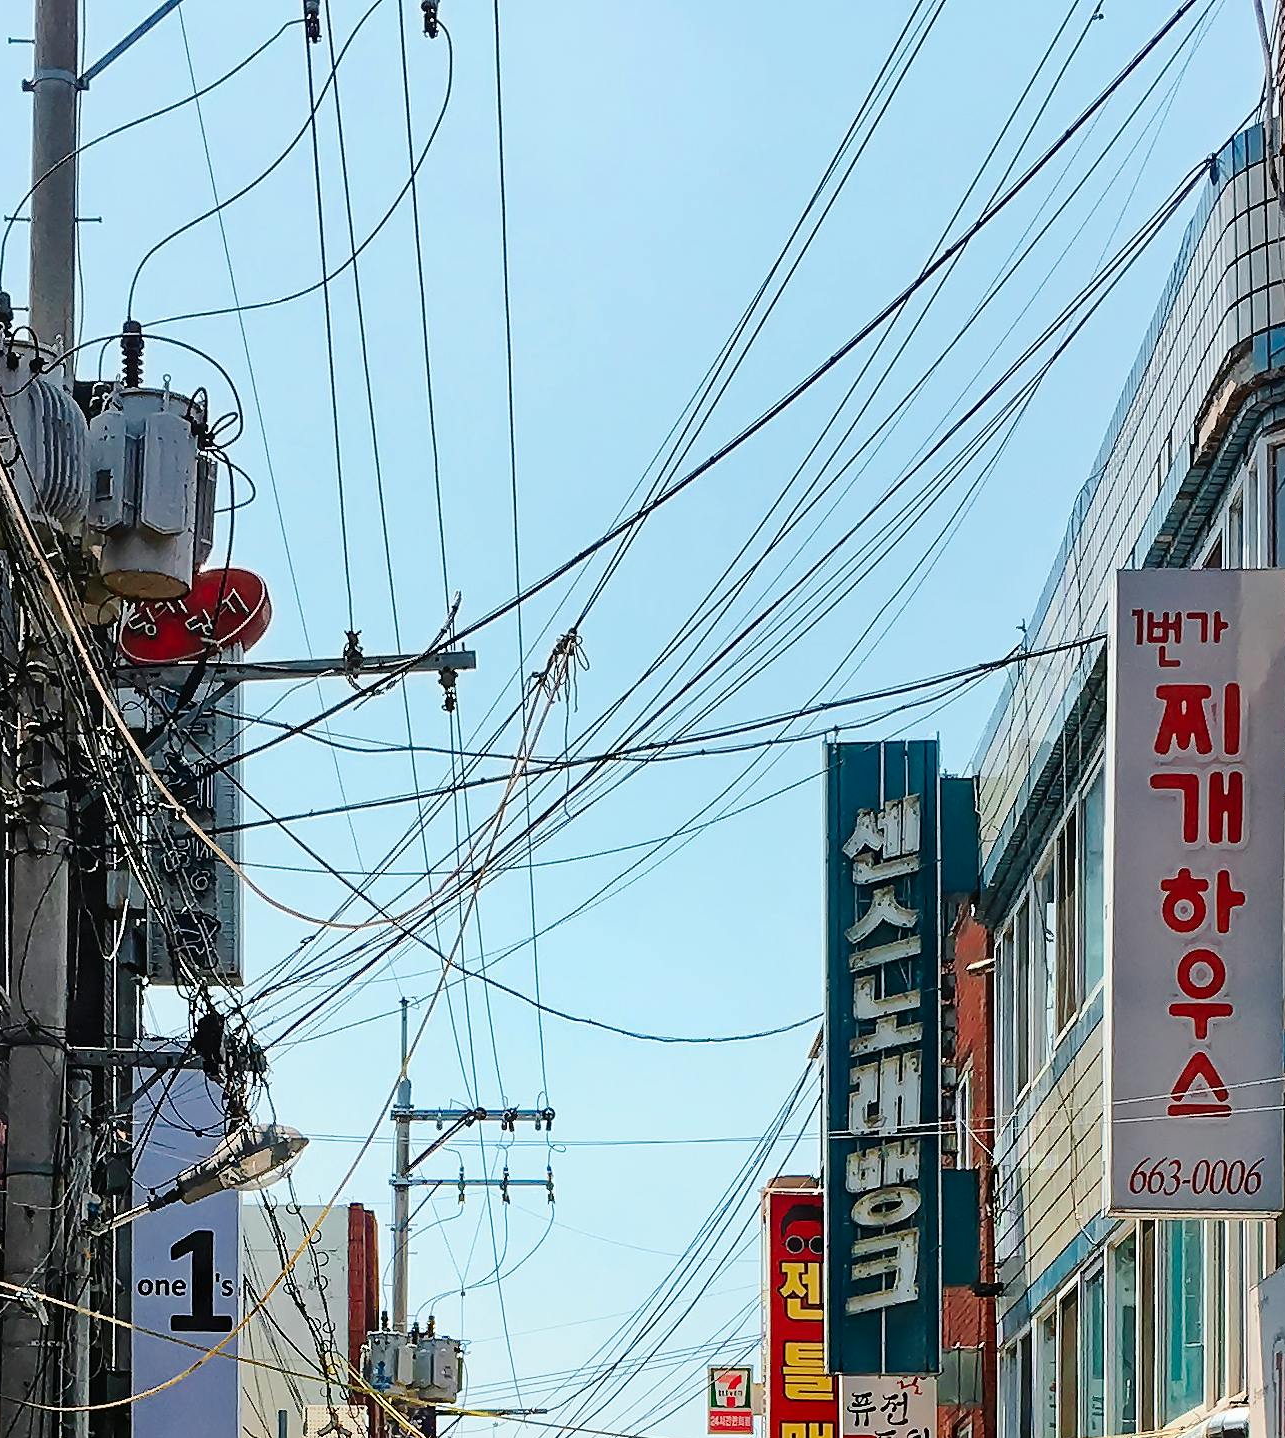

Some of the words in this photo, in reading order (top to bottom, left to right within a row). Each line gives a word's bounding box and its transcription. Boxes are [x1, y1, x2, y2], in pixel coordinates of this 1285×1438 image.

[1150, 683, 1246, 1118] 찌개하우스
[1129, 1157, 1265, 1197] 663-0006
[846, 1391, 909, 1427] 퓨전
